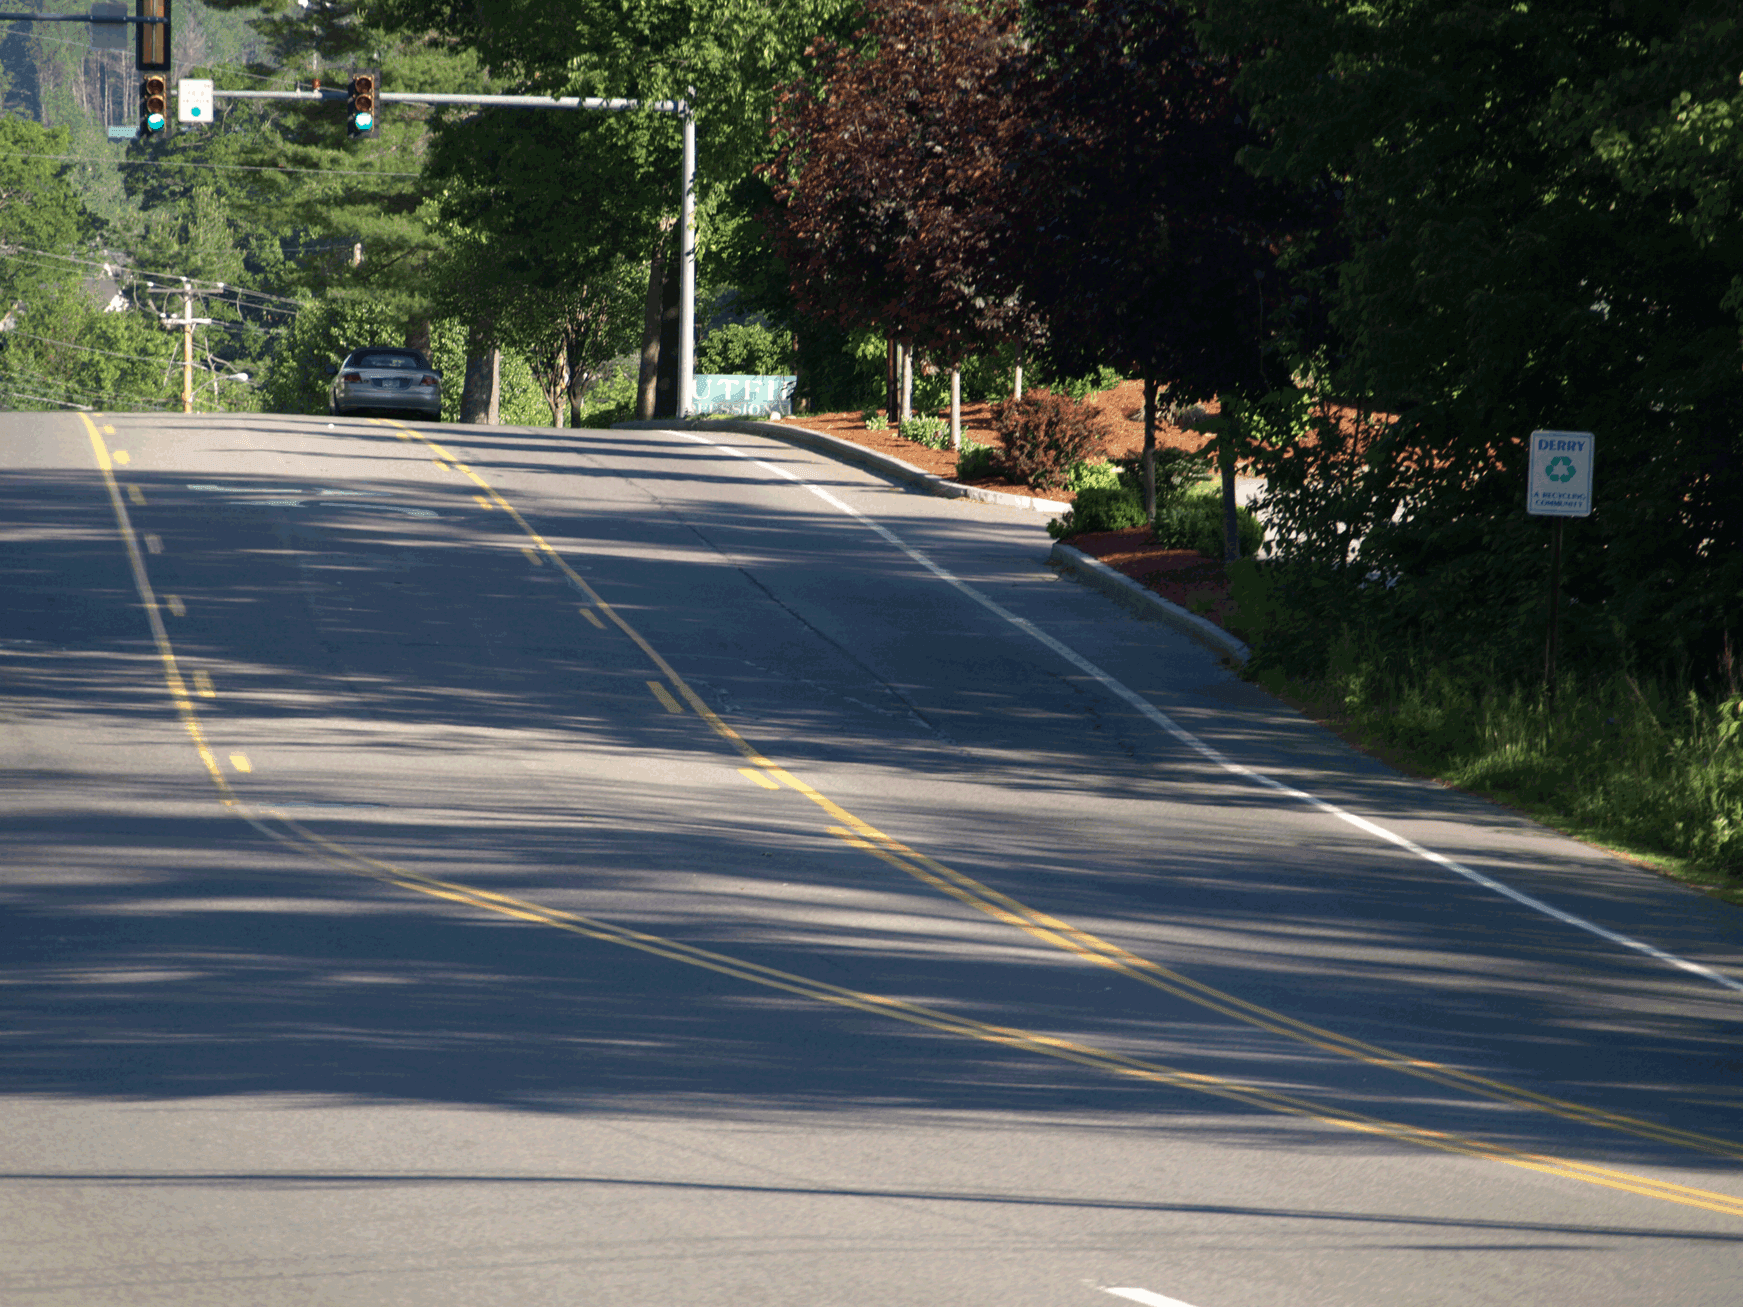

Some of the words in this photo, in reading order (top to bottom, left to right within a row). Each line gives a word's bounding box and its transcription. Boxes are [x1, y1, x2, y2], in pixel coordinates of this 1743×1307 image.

[1538, 439, 1586, 452] DERRY
[1542, 492, 1587, 501] RECYCLING
[1535, 499, 1583, 508] COMMUNITY
